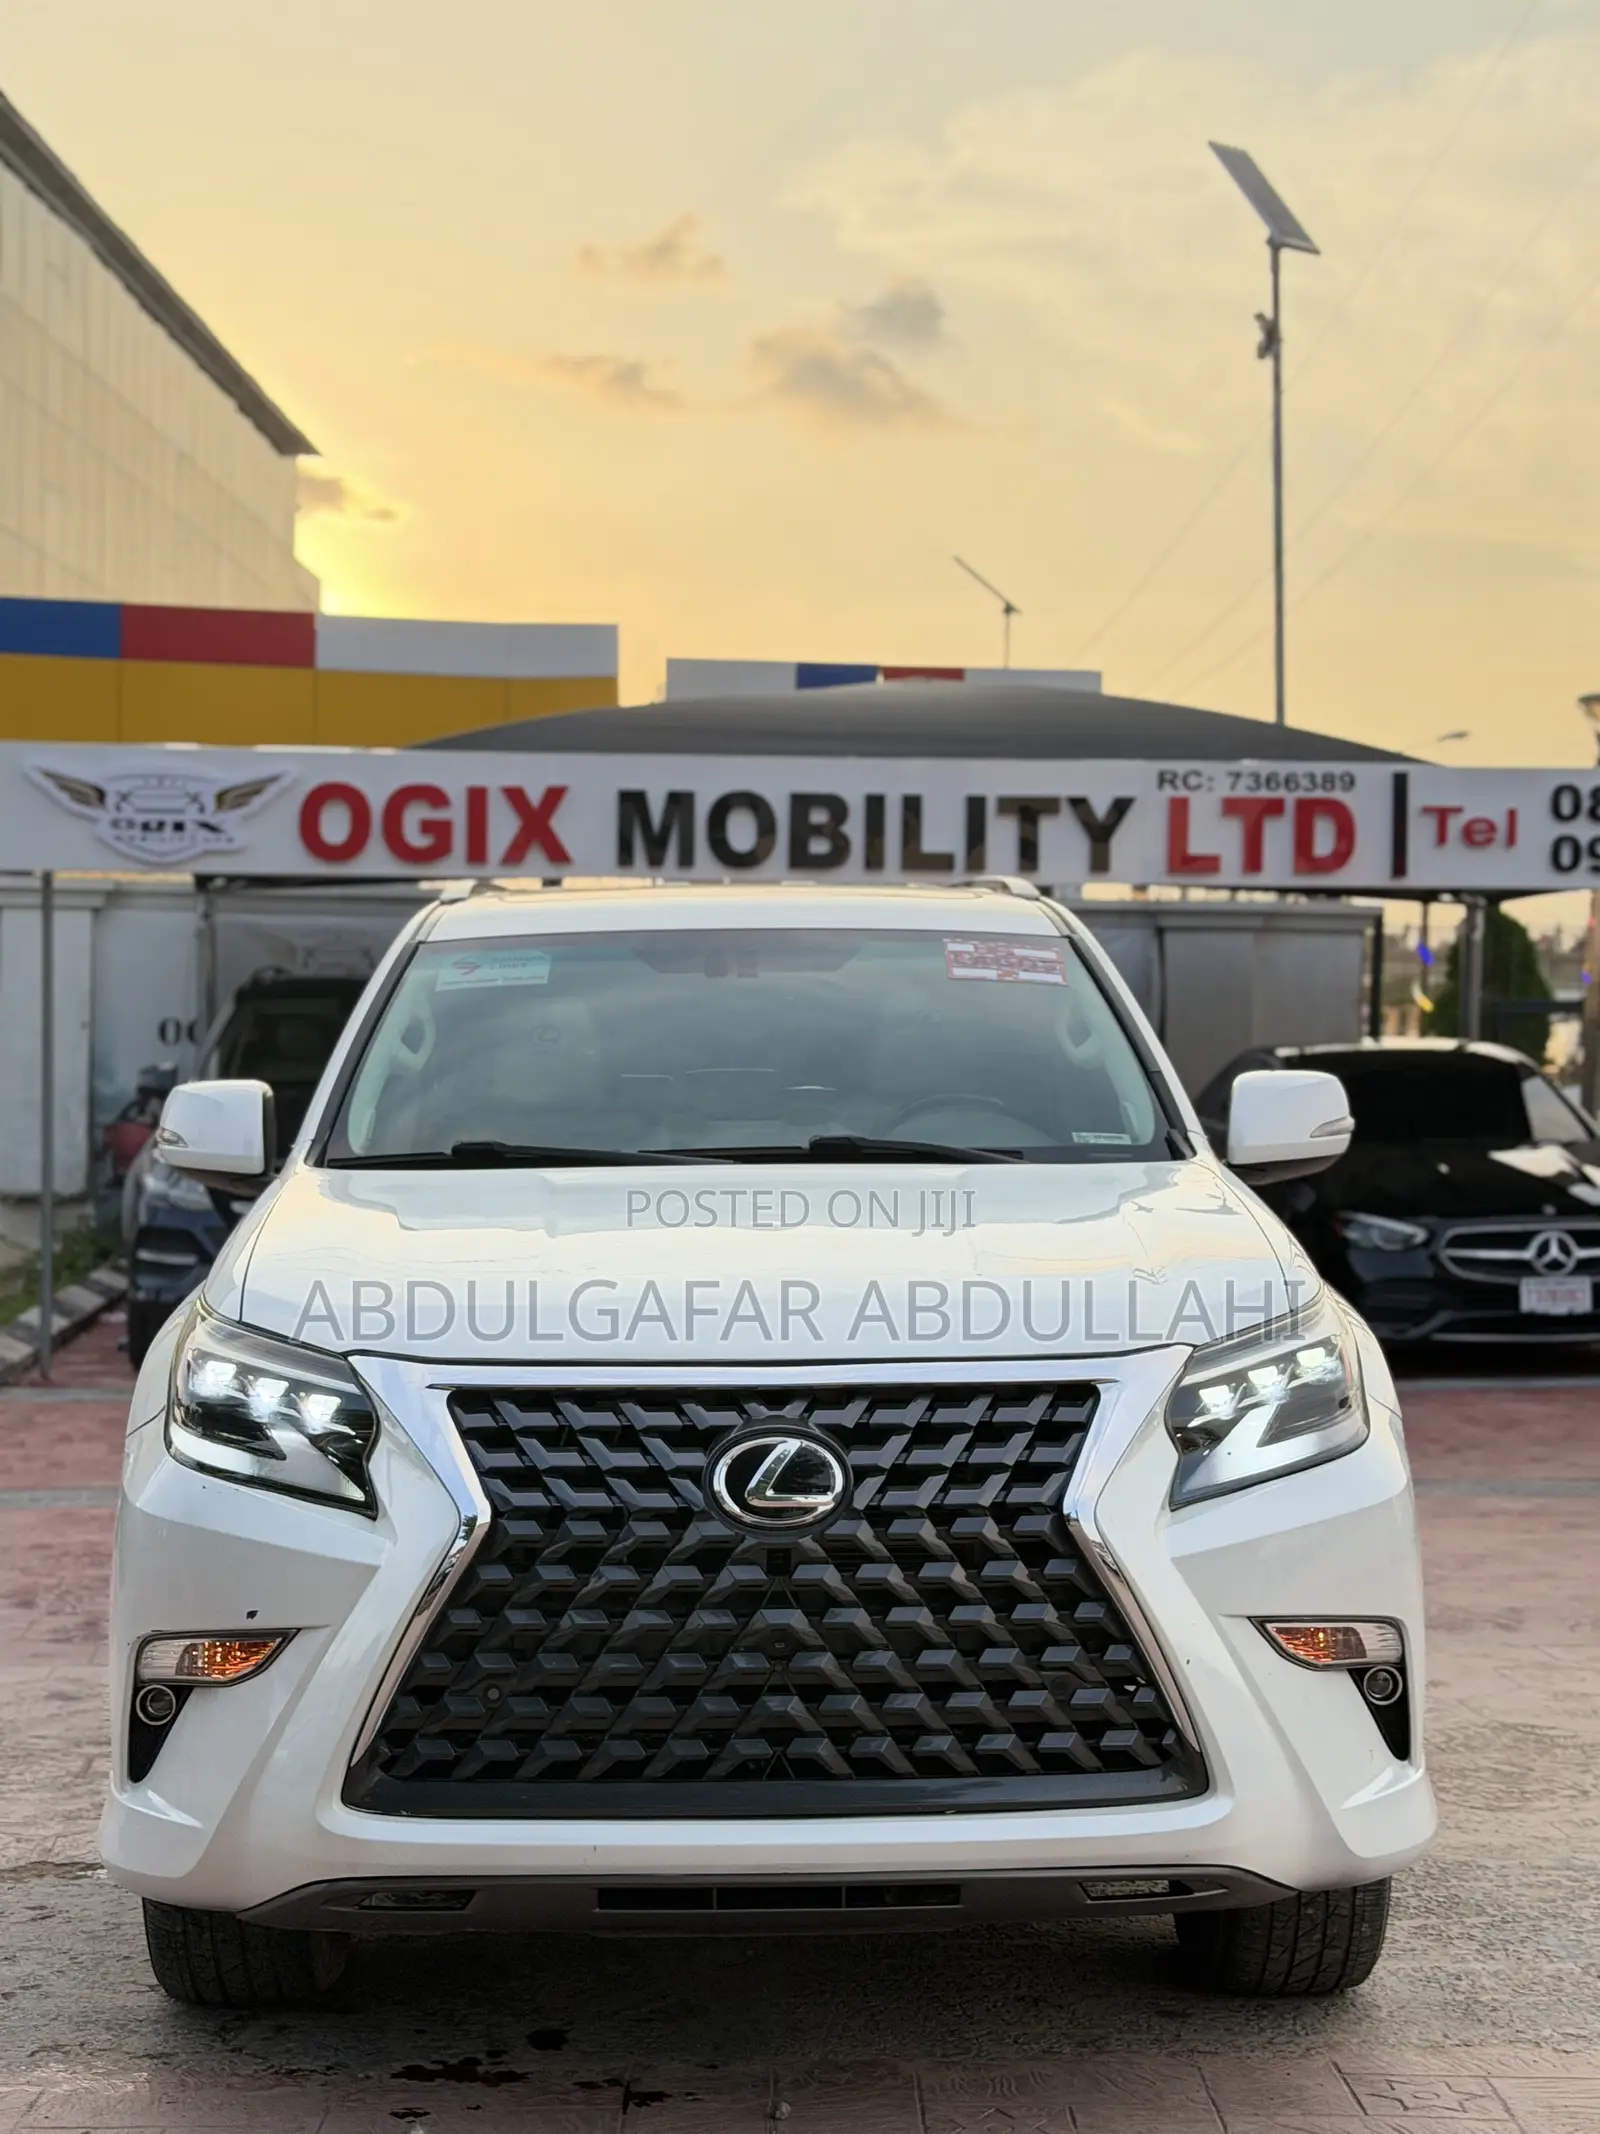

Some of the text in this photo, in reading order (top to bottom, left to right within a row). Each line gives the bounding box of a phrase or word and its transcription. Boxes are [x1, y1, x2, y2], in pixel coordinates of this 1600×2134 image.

[1157, 769, 1357, 793] RC: 7366389
[298, 780, 1357, 877] OGIX MOBILITY LTD
[1421, 805, 1518, 848] Tel
